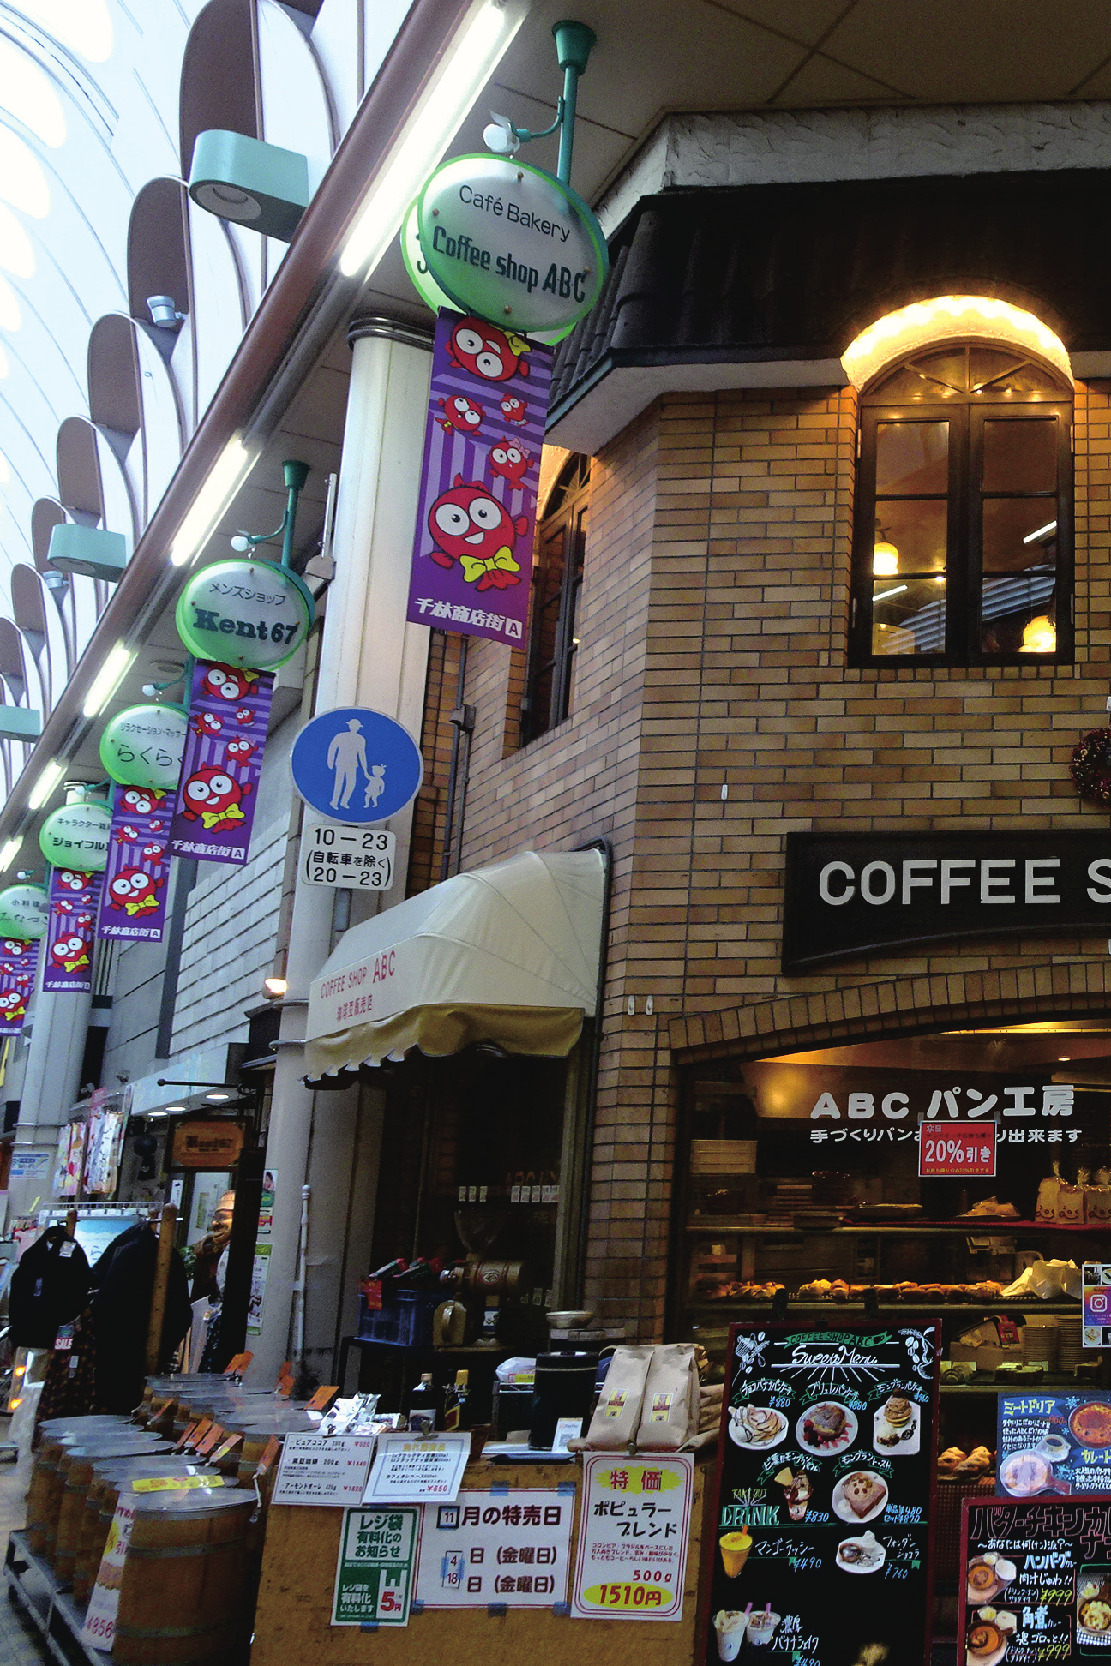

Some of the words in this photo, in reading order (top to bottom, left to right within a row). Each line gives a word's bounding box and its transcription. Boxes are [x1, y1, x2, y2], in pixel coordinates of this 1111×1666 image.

[459, 185, 504, 216] Café
[507, 203, 570, 243] Bakery
[433, 225, 491, 270] Coffee
[496, 253, 538, 293] shop
[209, 583, 286, 606] メンズショップ
[818, 858, 1062, 906] COFFEE
[373, 950, 396, 984] ABC
[810, 1092, 910, 1119] ABC
[926, 1085, 1075, 1119] パン工房
[54, 1337, 74, 1350] SALE
[1003, 1398, 1056, 1416] ミートドリア
[610, 1470, 664, 1492] 特価
[461, 1505, 562, 1527] 月の特売日
[593, 1500, 672, 1518] ポピュラー
[360, 1514, 404, 1531] レジ袋
[616, 1521, 678, 1538] ブレンド
[356, 1530, 402, 1544] 有料化の
[355, 1545, 401, 1558] お知らせ
[470, 1548, 485, 1565] 日
[450, 1556, 458, 1567] 4
[467, 1576, 482, 1593] 日
[633, 1569, 673, 1583] 500g
[600, 1584, 662, 1606] 1510円
